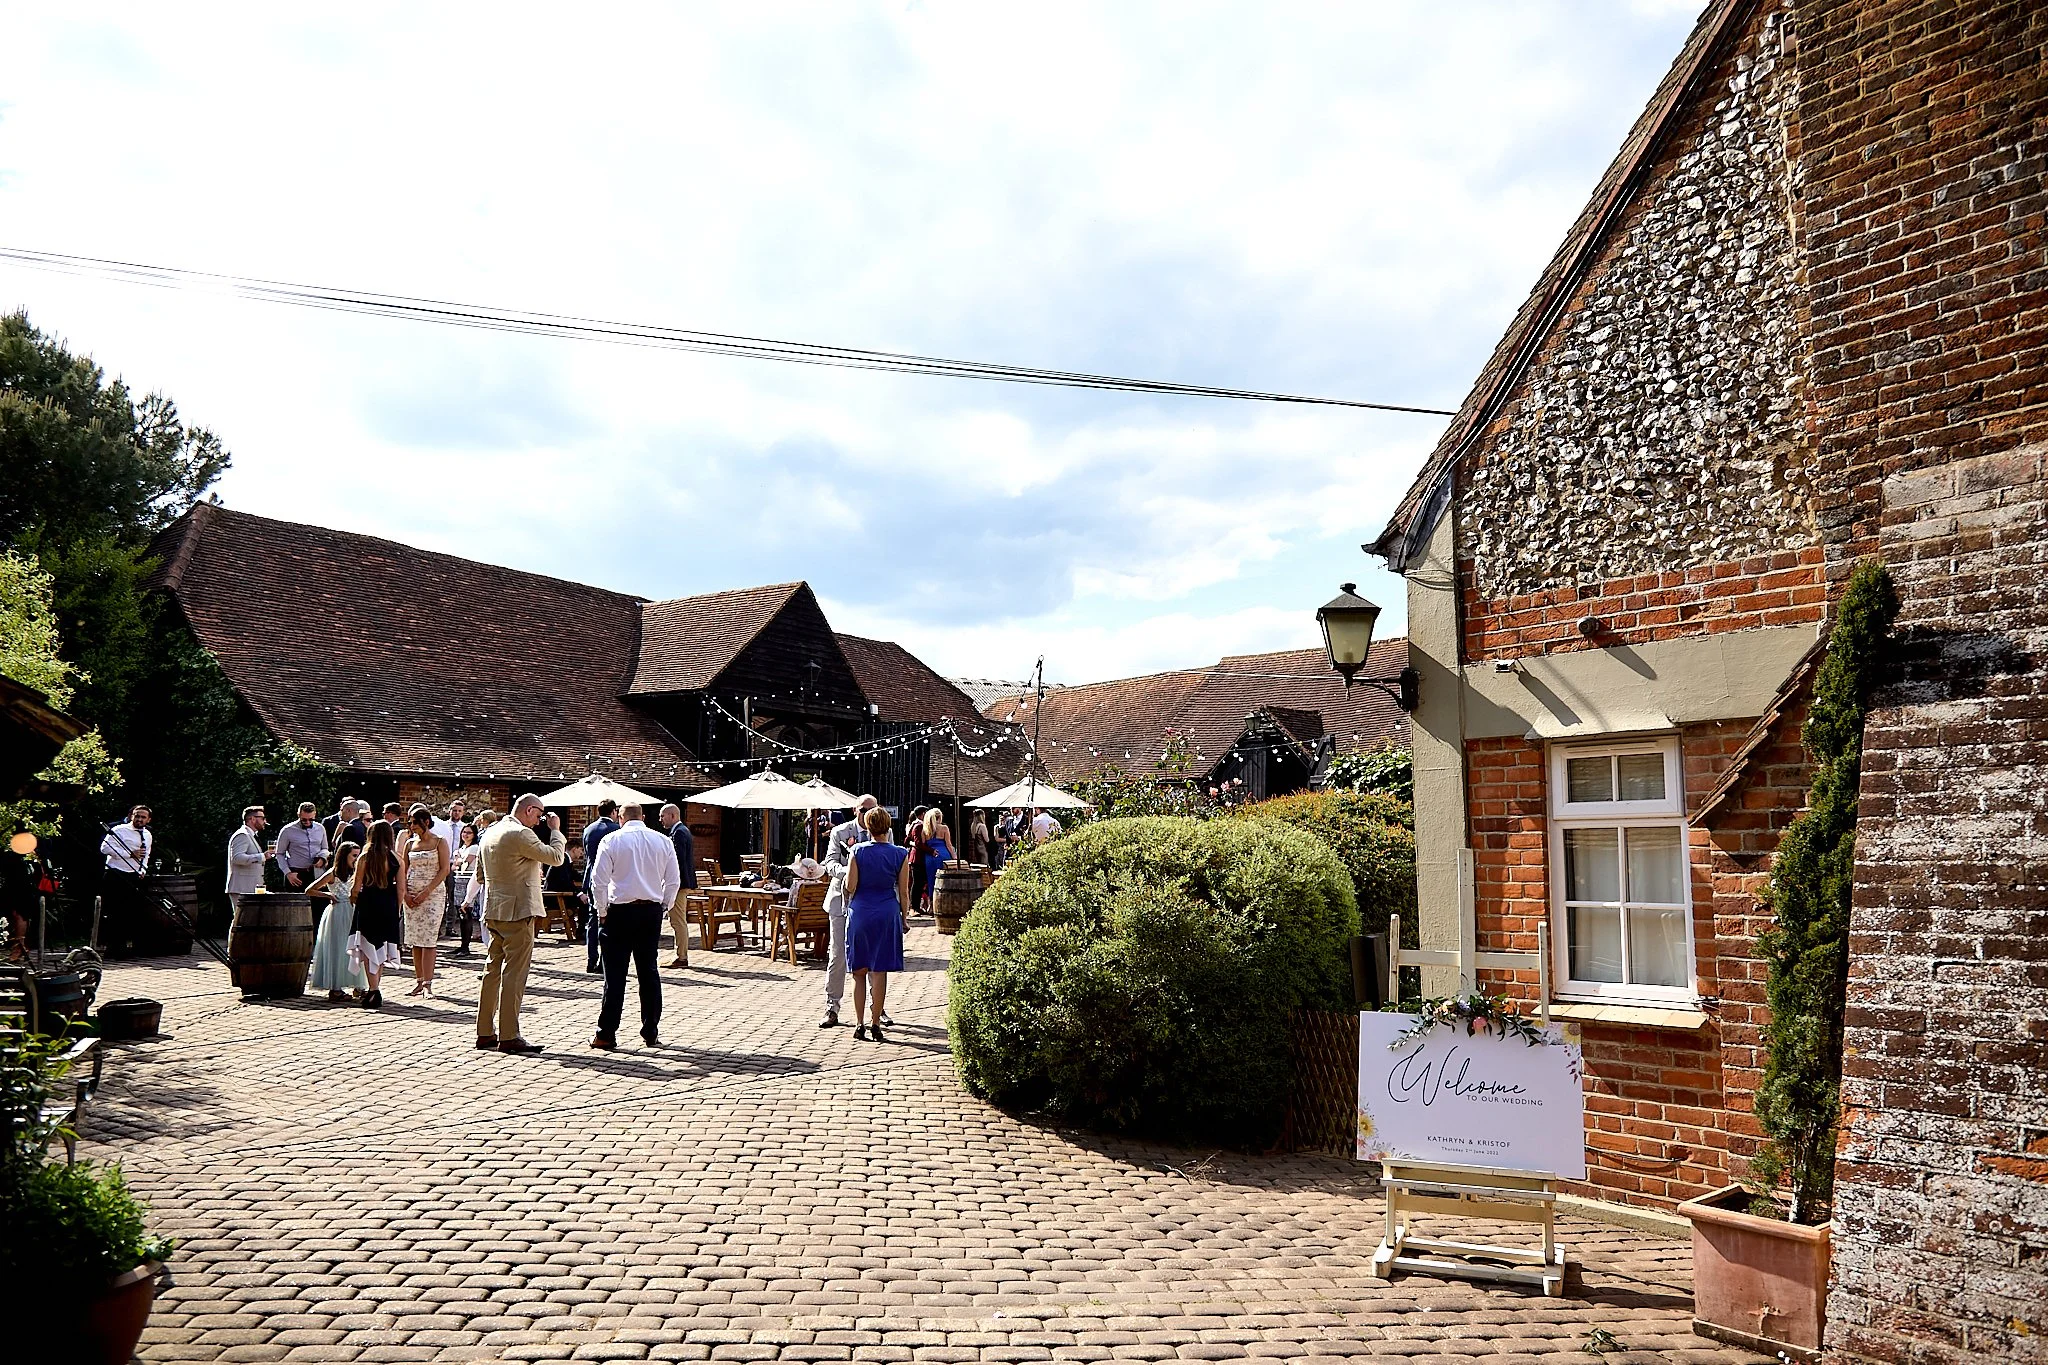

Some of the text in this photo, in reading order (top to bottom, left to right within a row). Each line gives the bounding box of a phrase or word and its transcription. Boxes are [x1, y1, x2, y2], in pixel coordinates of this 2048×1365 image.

[1388, 1043, 1526, 1106] Welcome
[1502, 1097, 1543, 1106] WEDDING
[1427, 1135, 1465, 1144] KATHRYN
[1477, 1139, 1511, 1148] KRISTOF
